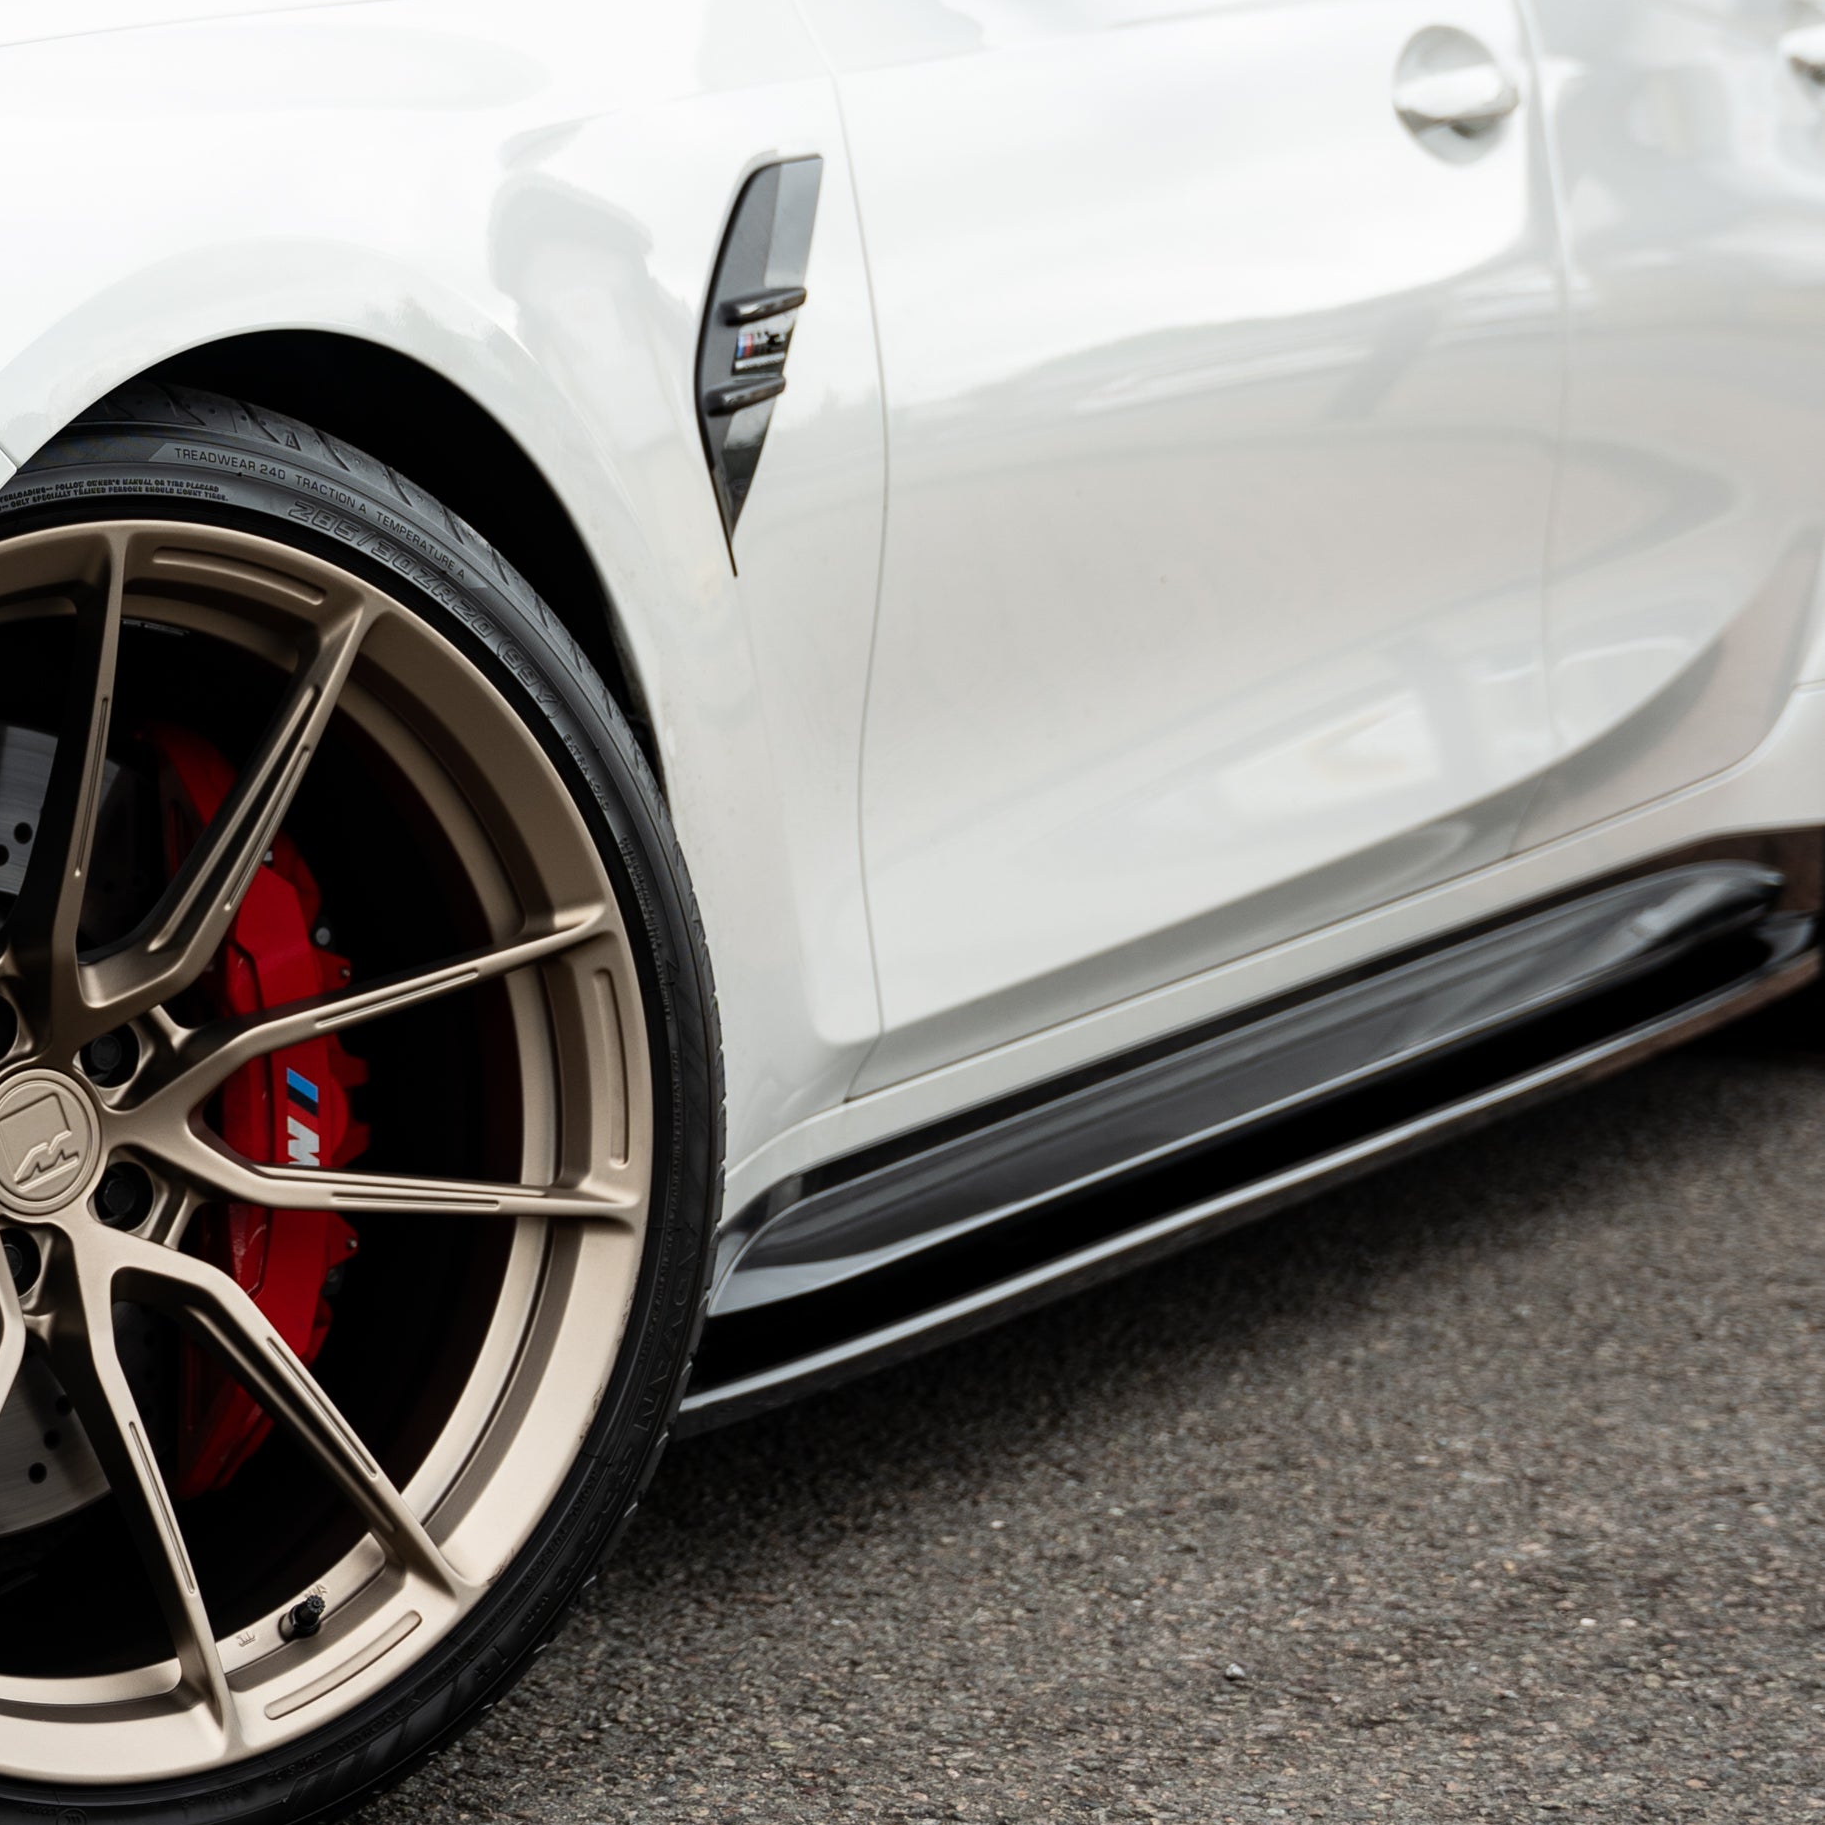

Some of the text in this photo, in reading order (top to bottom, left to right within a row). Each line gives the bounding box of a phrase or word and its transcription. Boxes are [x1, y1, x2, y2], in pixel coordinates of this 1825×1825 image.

[175, 447, 468, 580] TREADWEAR 240 TRACTION A TEMPERATURE A
[287, 499, 496, 639] 285/30ZR20
